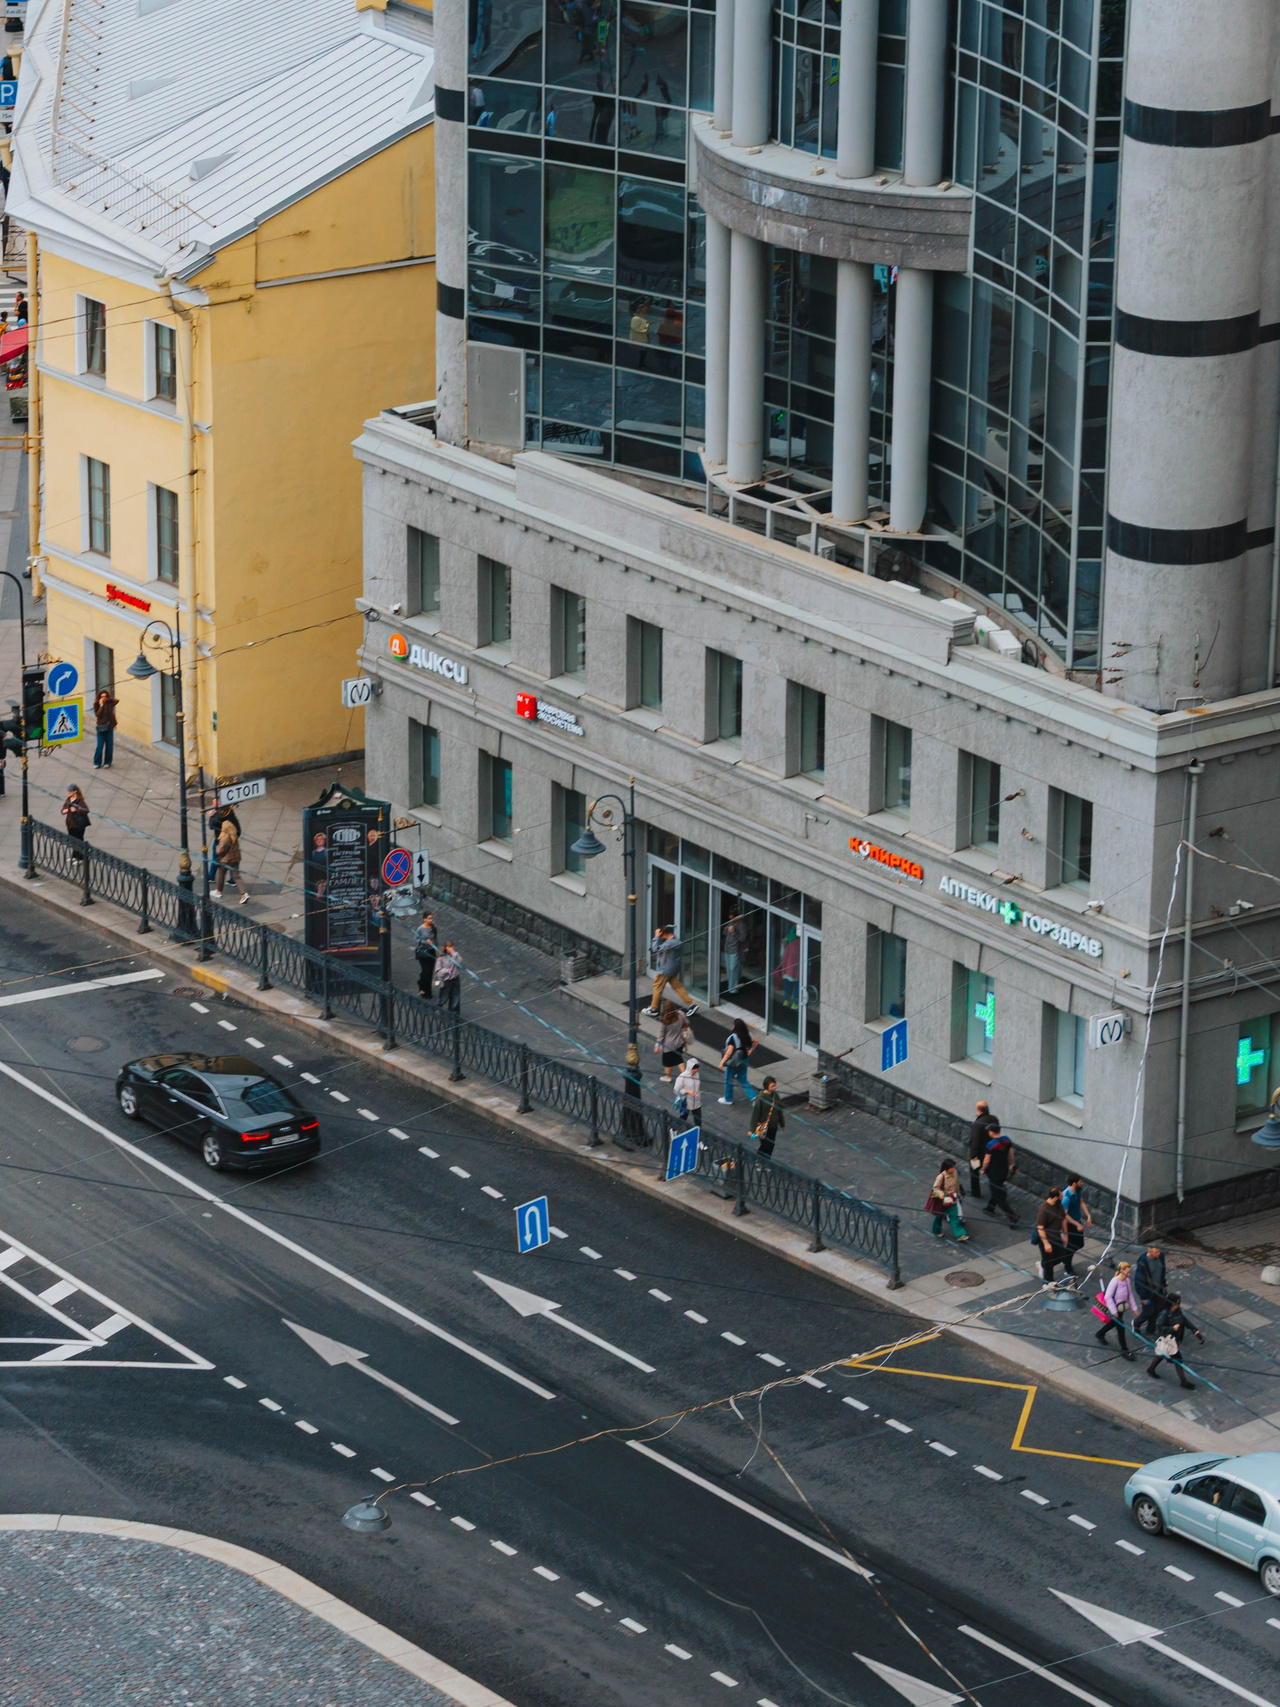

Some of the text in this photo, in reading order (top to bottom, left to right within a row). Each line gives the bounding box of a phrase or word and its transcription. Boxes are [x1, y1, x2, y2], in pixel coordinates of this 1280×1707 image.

[1, 84, 14, 103] P
[226, 782, 260, 801] СТОП
[848, 836, 924, 880] КОПИРКА
[329, 877, 365, 887] ГАМЛЕТ
[938, 875, 1104, 958] АПТЕКИ ГОРЗДРАВ
